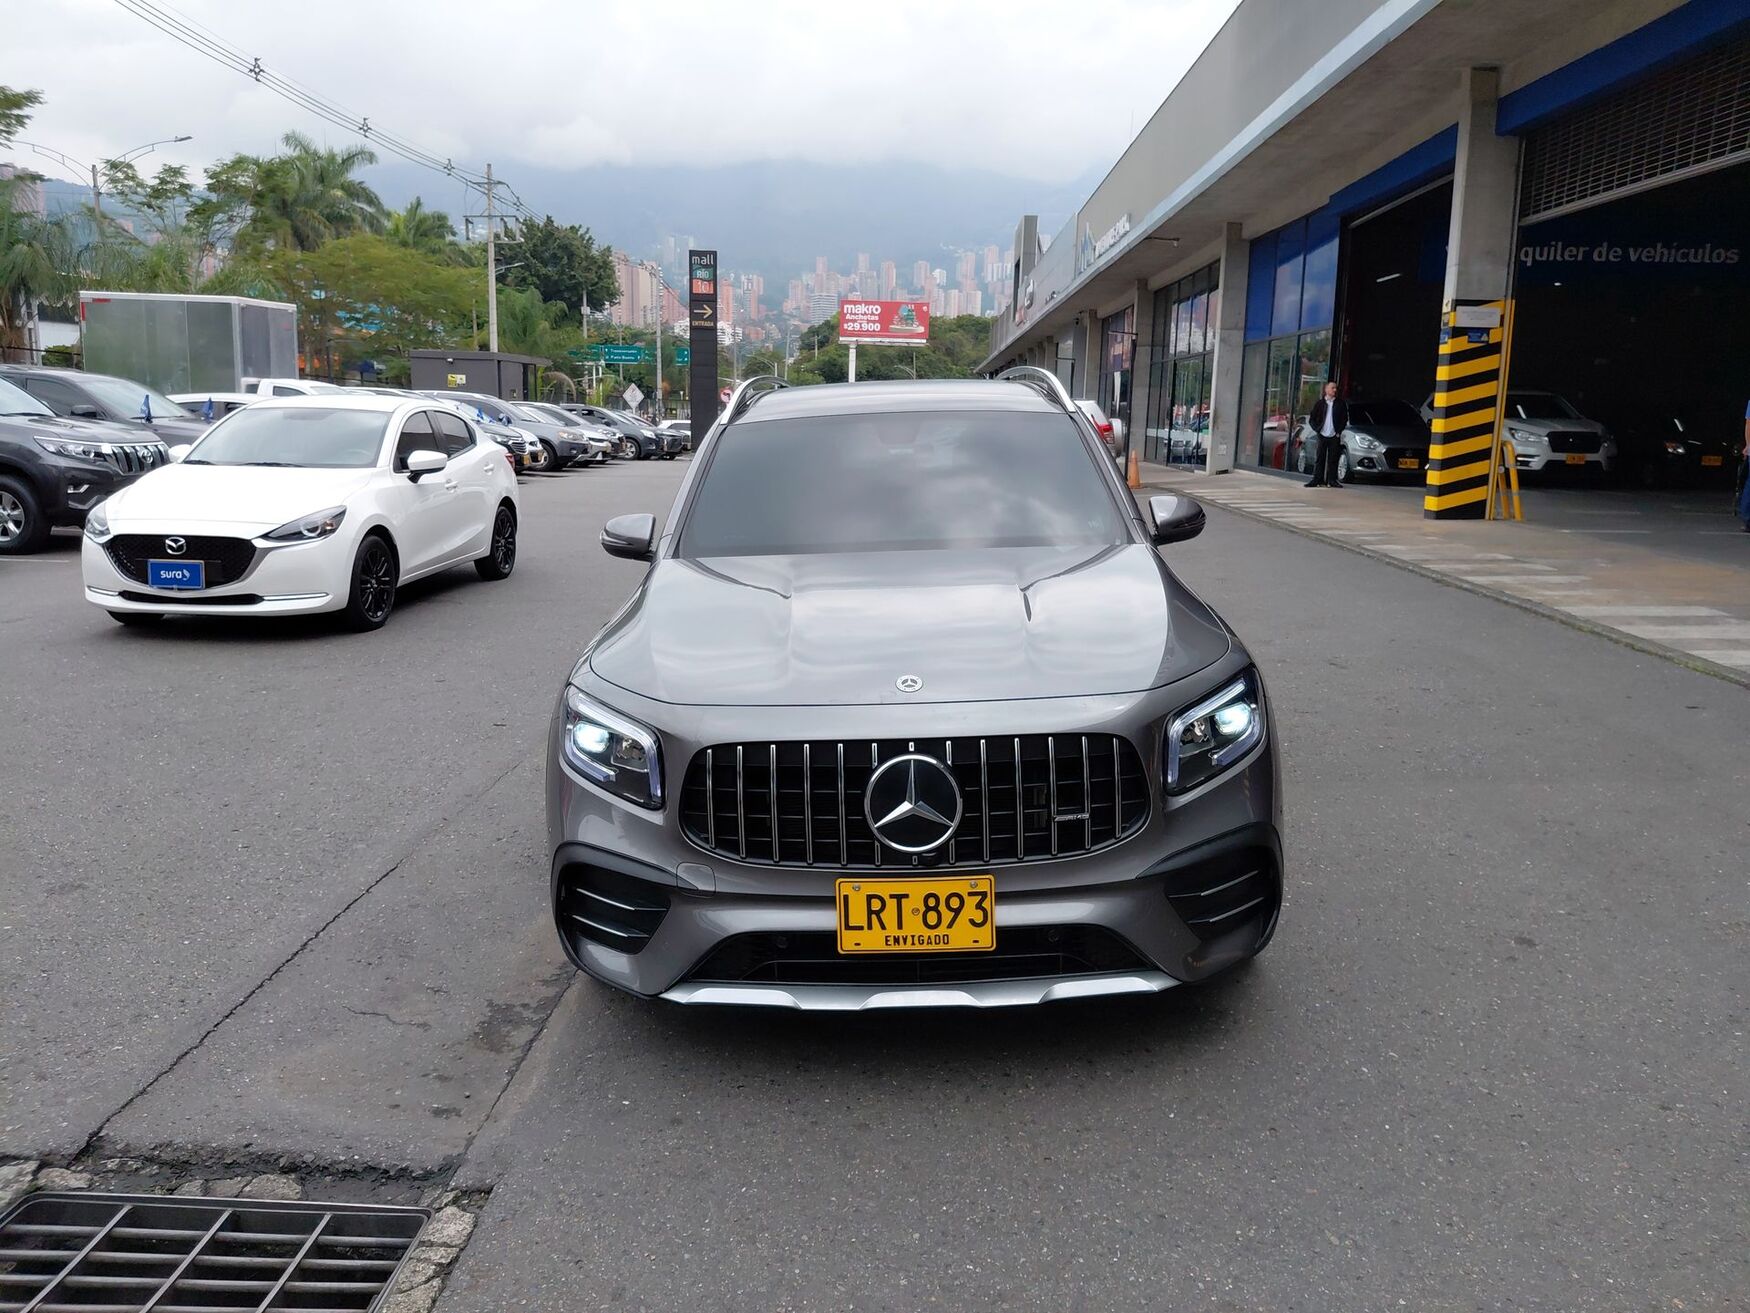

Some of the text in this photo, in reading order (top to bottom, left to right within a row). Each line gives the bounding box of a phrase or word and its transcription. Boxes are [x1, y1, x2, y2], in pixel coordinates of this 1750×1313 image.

[1593, 242, 1622, 262] de
[691, 254, 714, 265] mall
[843, 303, 882, 315] makro
[845, 313, 879, 321] Anchetas
[692, 320, 715, 328] ENTRADA
[843, 322, 881, 332] $29.900
[160, 570, 182, 579] sura
[842, 890, 989, 932] LRT 893
[884, 933, 950, 947] ENVIGADO
